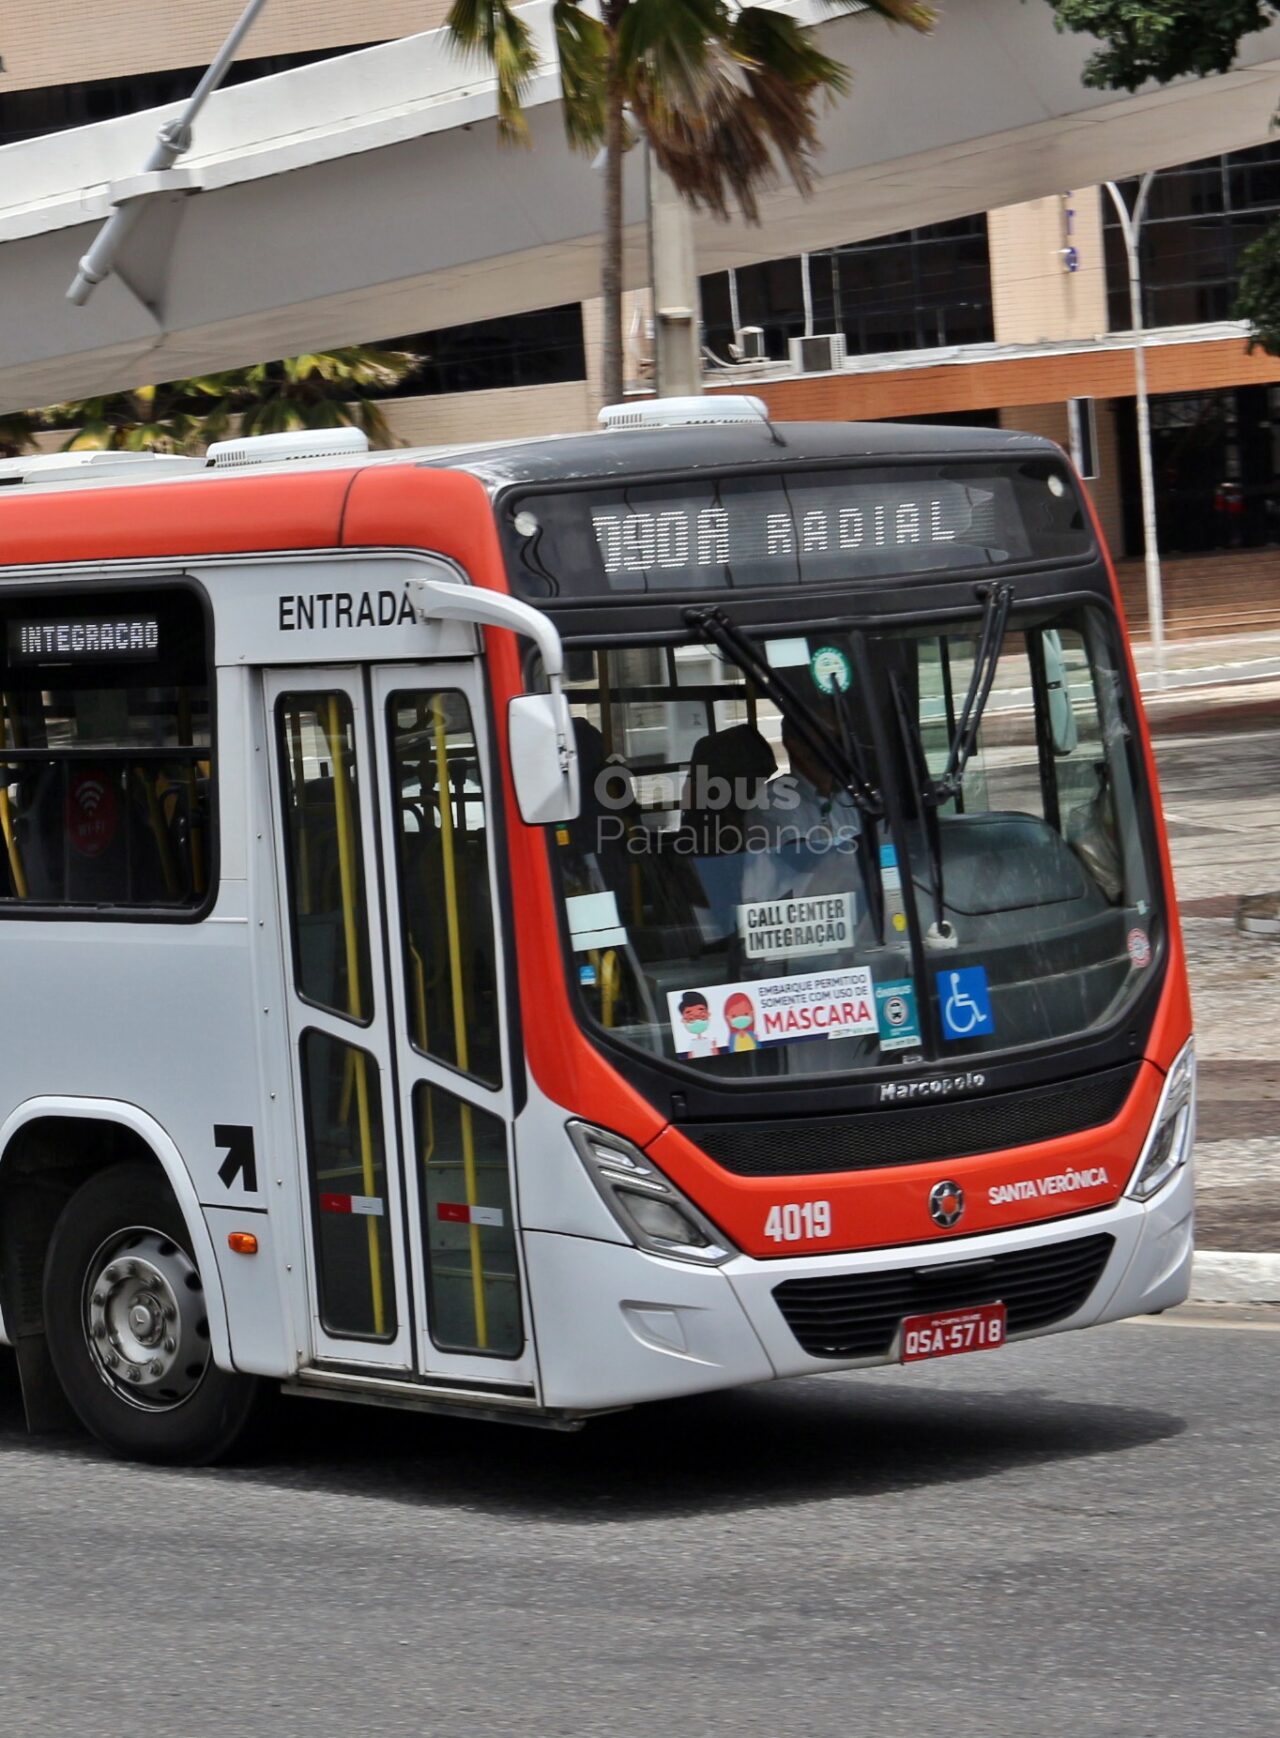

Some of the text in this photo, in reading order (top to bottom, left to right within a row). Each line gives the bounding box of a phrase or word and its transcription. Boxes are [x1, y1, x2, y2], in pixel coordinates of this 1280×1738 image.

[767, 501, 956, 554] RADIAL
[278, 590, 418, 631] ENTRADA
[21, 622, 158, 652] INTEGRACAO
[747, 899, 845, 928] CALL CENTER
[748, 920, 847, 951] INTEGRAÇÃO
[758, 973, 868, 997] EMBARQUE PERMITIDO
[760, 985, 869, 1009] SOMENTE COM USO DE
[762, 1000, 873, 1035] MÁSCARA
[880, 1072, 986, 1101] Marcopolo
[988, 1166, 1109, 1205] SANTA VERÔNICA
[764, 1201, 832, 1242] 4019
